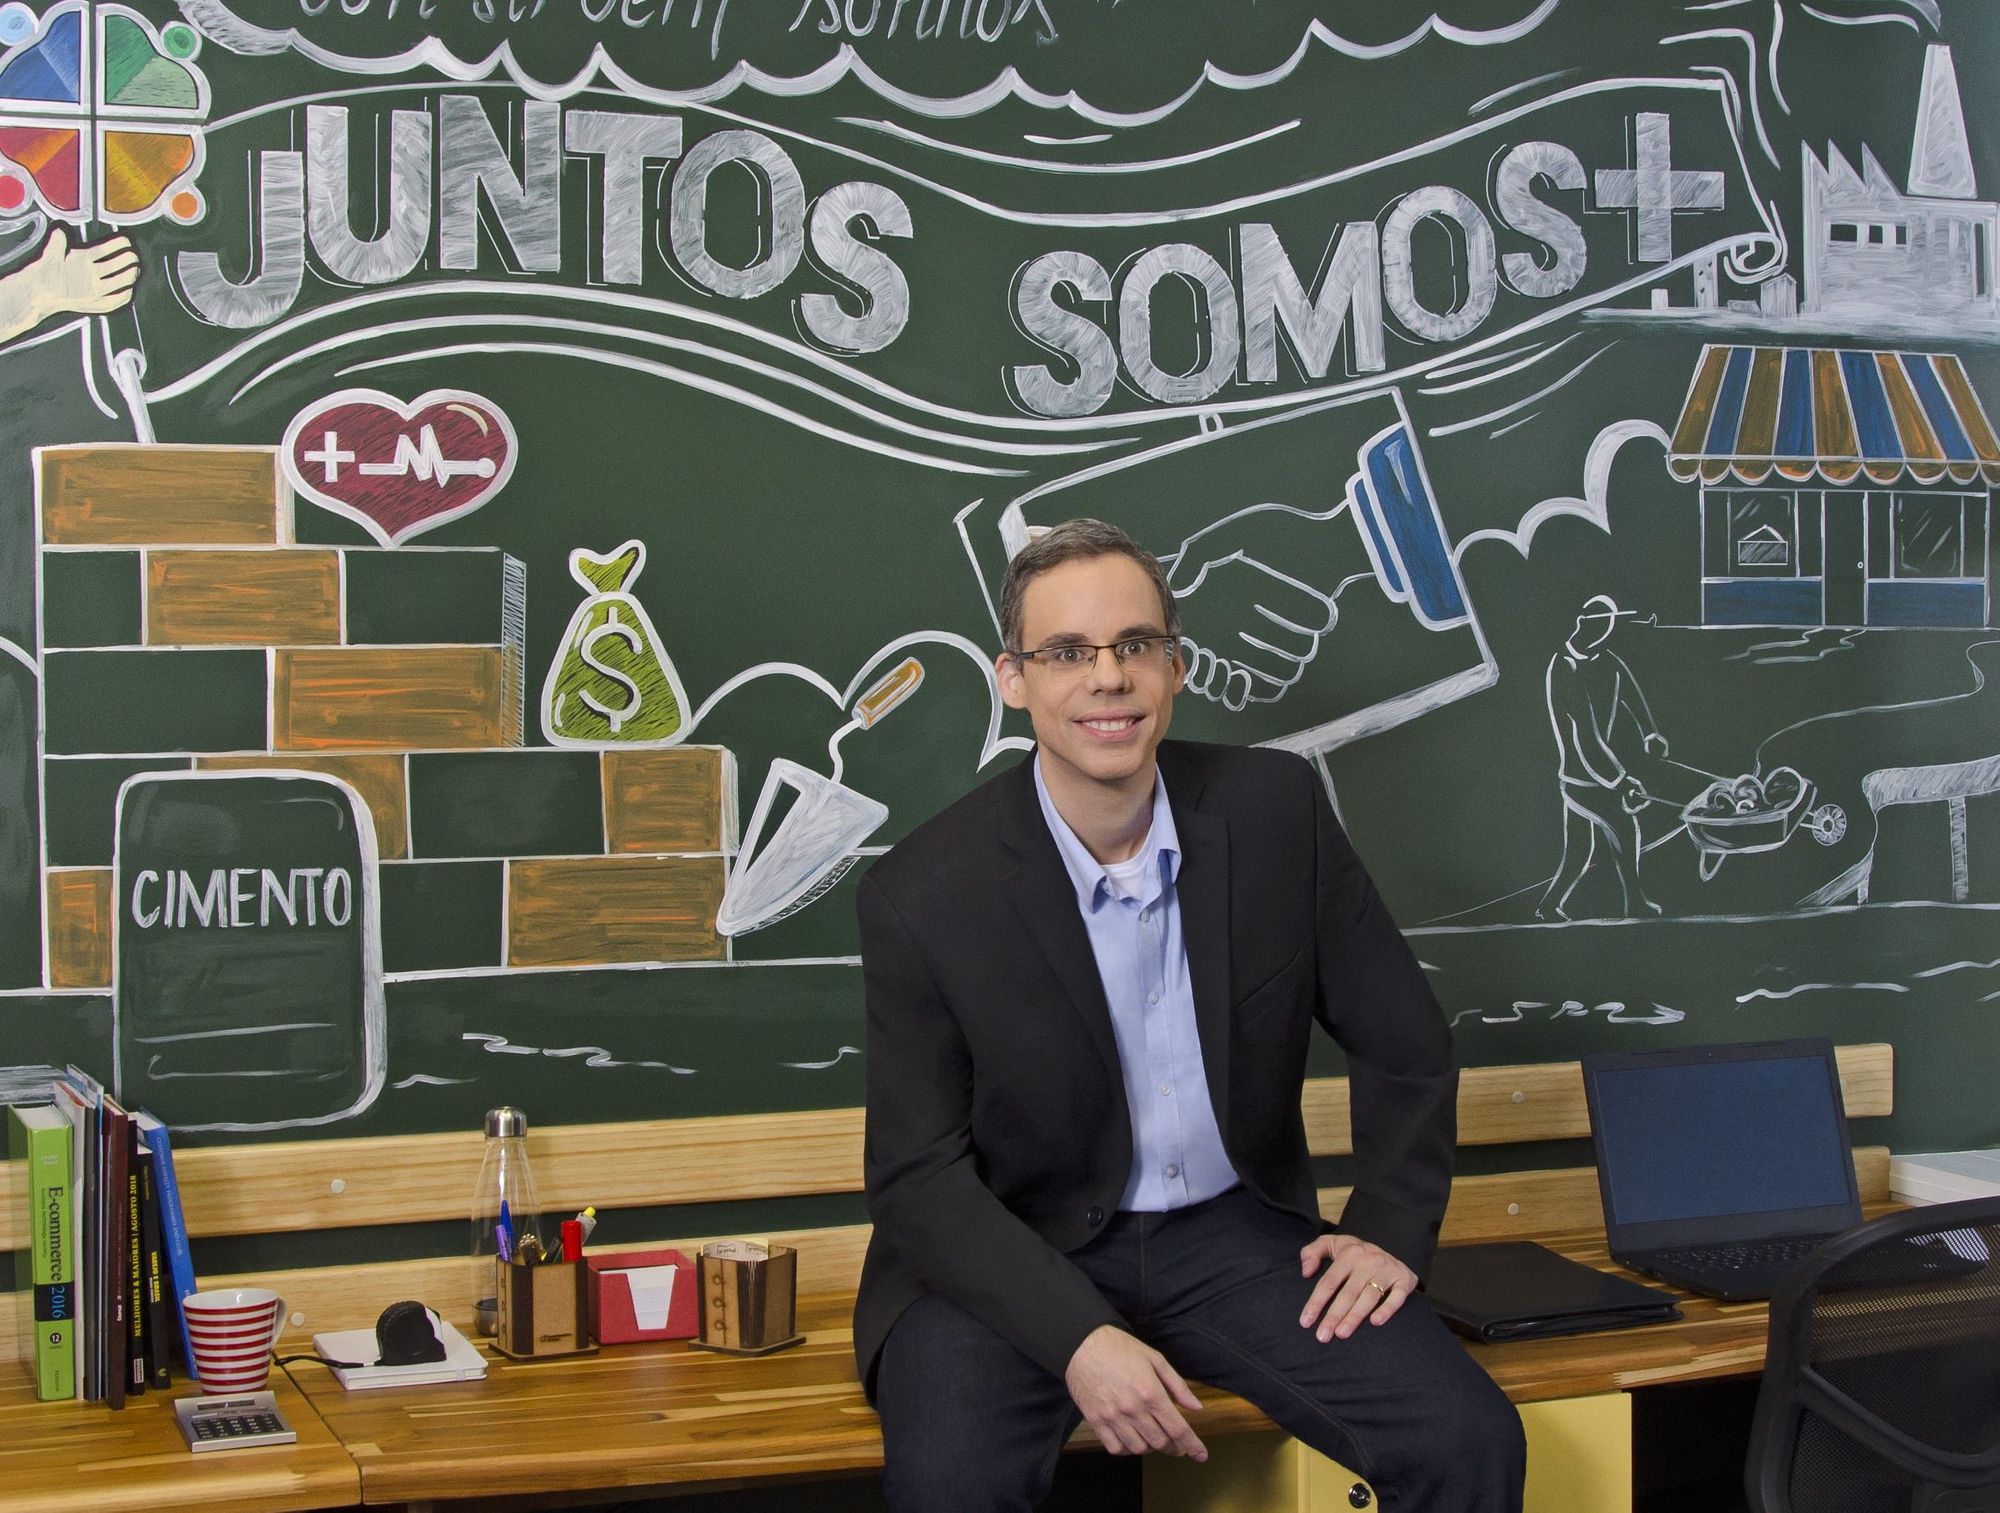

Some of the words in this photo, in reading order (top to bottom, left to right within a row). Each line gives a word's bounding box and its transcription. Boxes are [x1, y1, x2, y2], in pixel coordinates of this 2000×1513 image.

[172, 94, 914, 354] JUNTOS
[132, 867, 352, 929] CIMENTO
[49, 1187, 64, 1281] E-commerce
[130, 1197, 138, 1231] AGOSTO
[51, 1286, 65, 1319] 2016
[51, 1334, 60, 1343] 12
